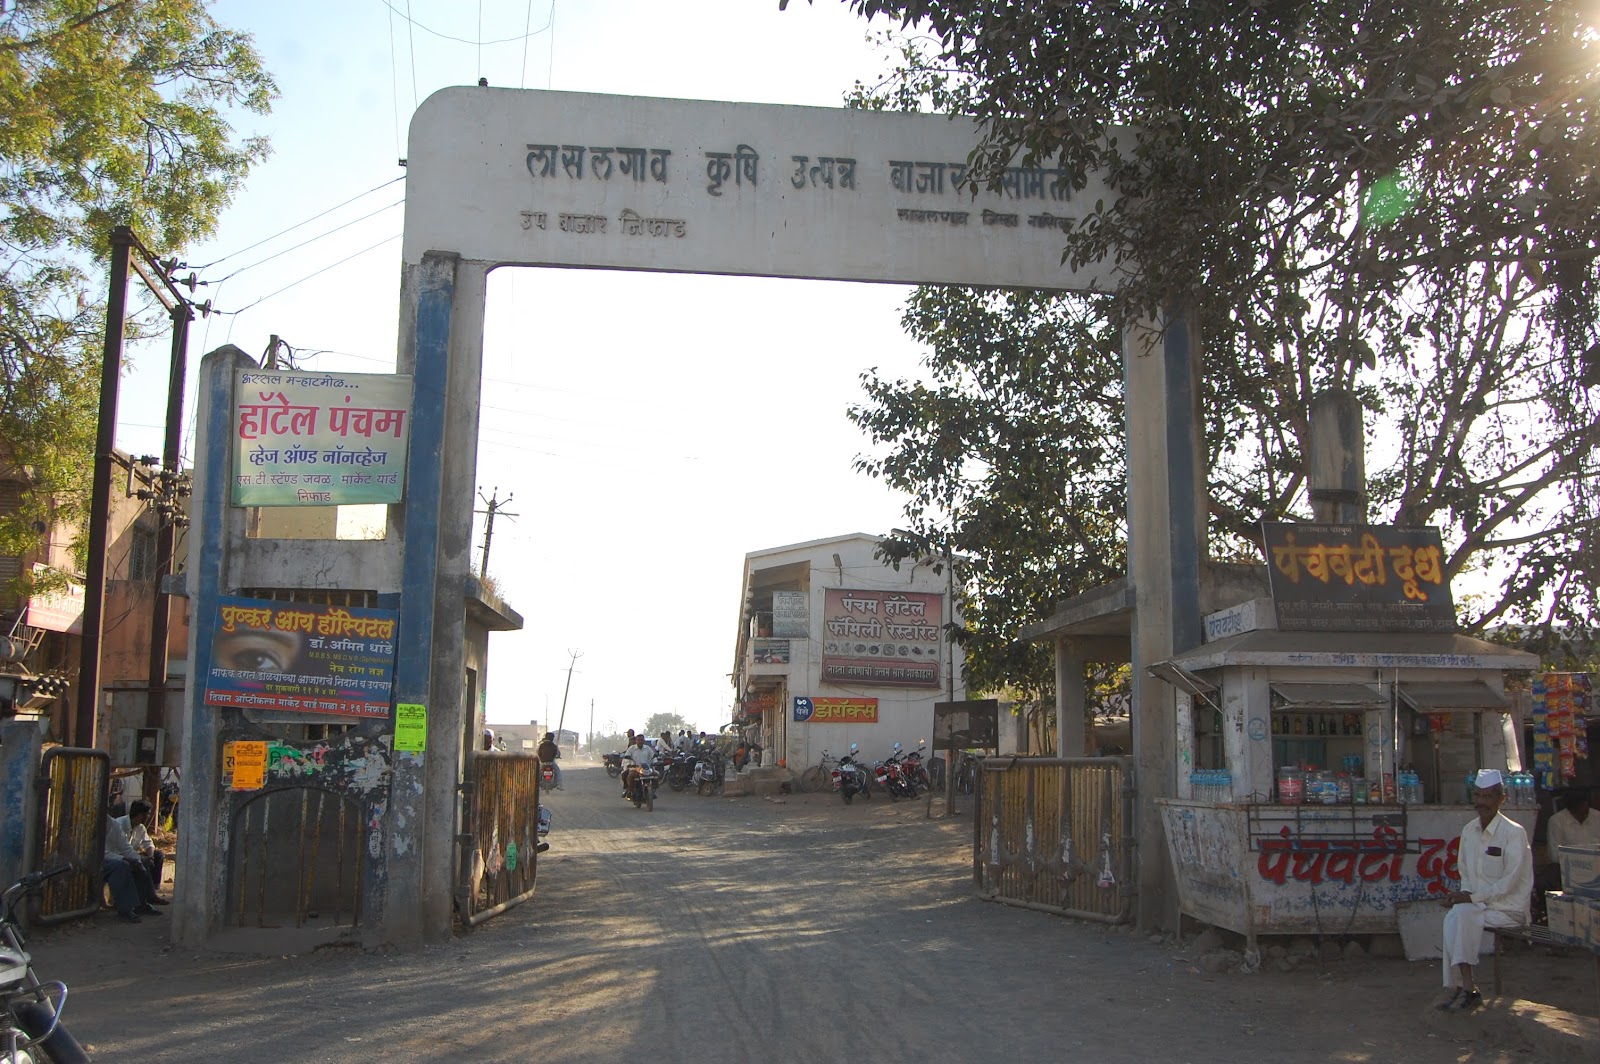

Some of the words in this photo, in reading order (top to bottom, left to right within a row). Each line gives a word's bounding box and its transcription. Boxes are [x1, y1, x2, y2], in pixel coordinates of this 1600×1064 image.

[526, 144, 671, 186] लासलगाव
[705, 144, 760, 197] कृषि
[791, 155, 857, 190] उत्पन्न
[889, 160, 970, 195] बाजार
[520, 210, 548, 232] उप
[558, 212, 608, 235] बाजार
[618, 208, 687, 238] निफाड
[242, 373, 281, 386] अस्सल
[239, 391, 321, 440] हॉटेल
[329, 395, 407, 438] पंचम
[249, 444, 280, 465] व्हेज
[323, 445, 388, 466] नॉनव्हेज
[341, 471, 372, 484] मार्केट
[376, 471, 398, 484] यार्ड
[297, 488, 332, 502] निफाड
[1272, 531, 1386, 585] पंचवटी
[1389, 544, 1442, 601] दूध
[841, 592, 879, 615] पंचम
[883, 595, 927, 618] हॉटेल
[221, 605, 273, 633] पुष्कर
[275, 610, 315, 633] आय
[317, 607, 395, 639] हॉस्पिटल
[827, 617, 882, 640] फॅमिली
[887, 619, 939, 642] रेस्टॉरंट
[329, 661, 345, 673] नेत्र
[348, 663, 366, 675] रोग
[335, 675, 359, 688] निदान
[360, 679, 366, 689] व
[209, 690, 232, 702] दिवान
[319, 701, 338, 710] गाळा
[364, 702, 390, 714] निफाड
[1257, 825, 1404, 886] पंचवटी
